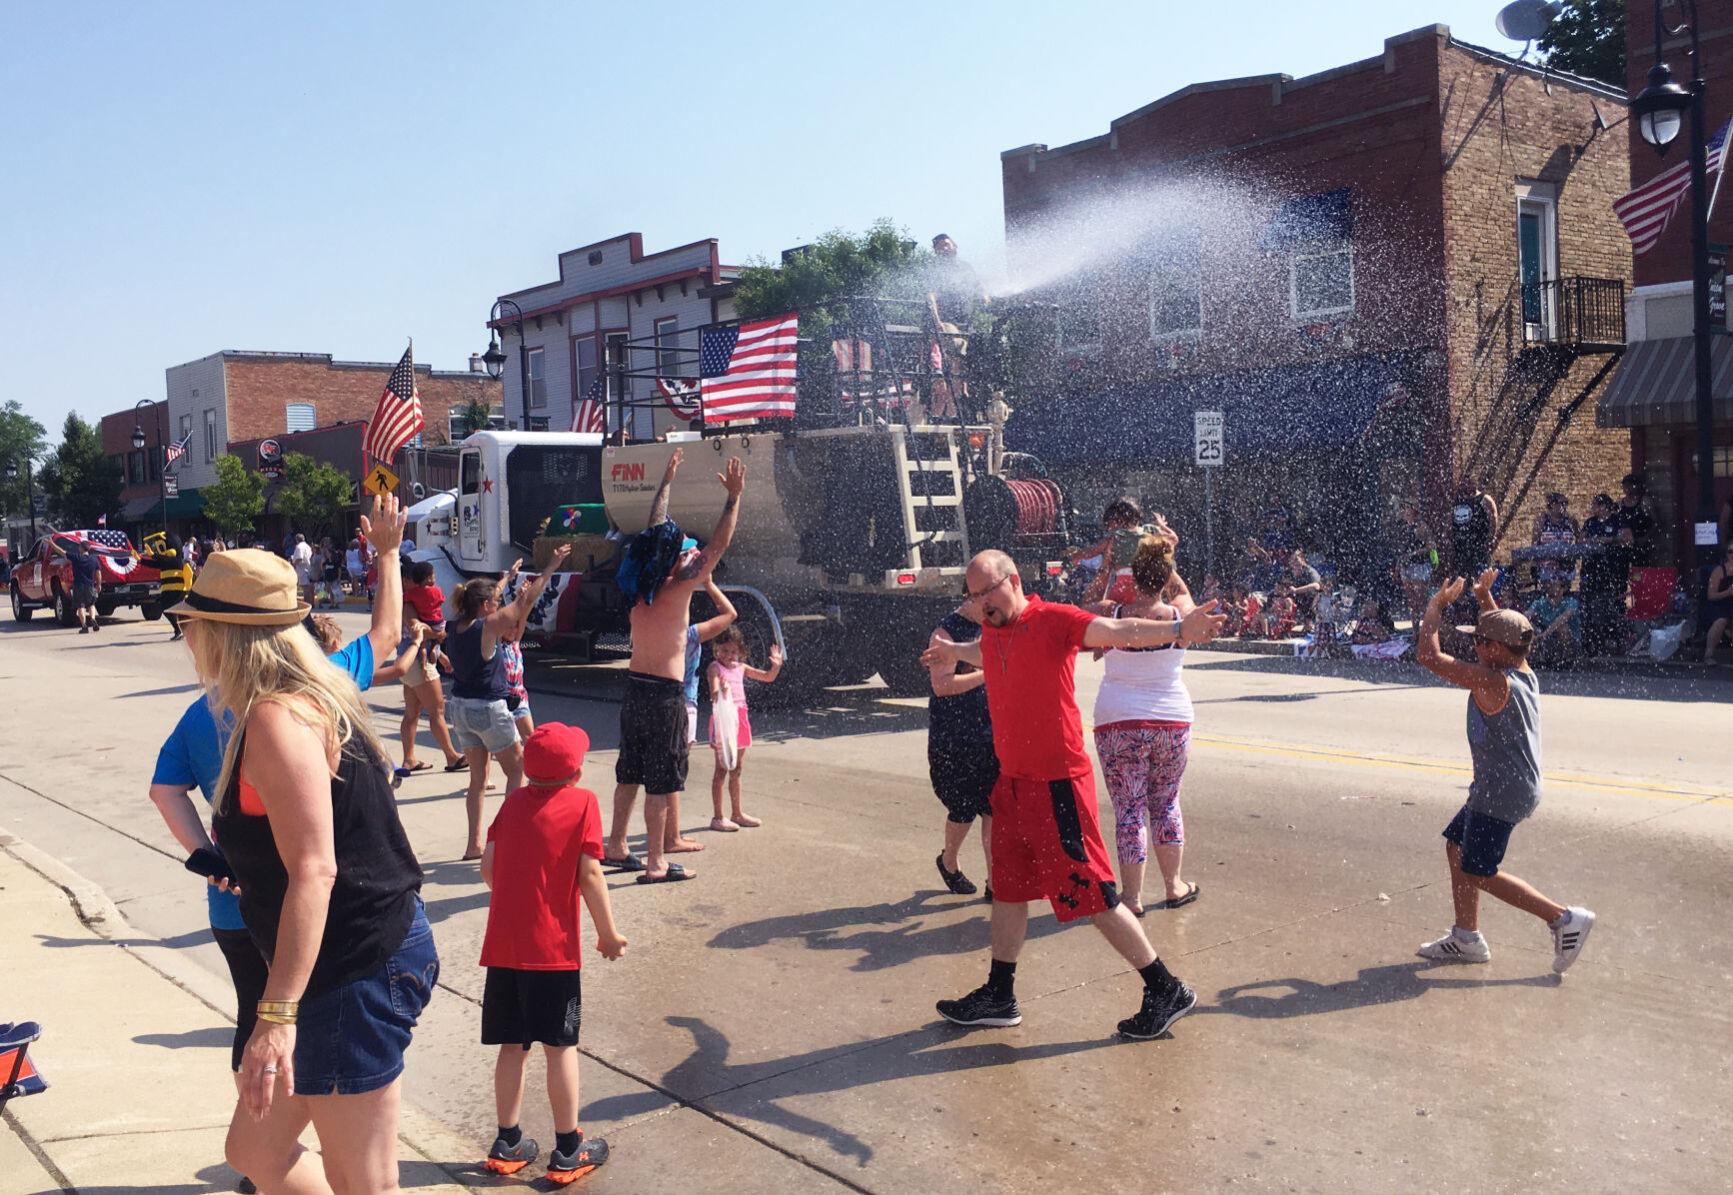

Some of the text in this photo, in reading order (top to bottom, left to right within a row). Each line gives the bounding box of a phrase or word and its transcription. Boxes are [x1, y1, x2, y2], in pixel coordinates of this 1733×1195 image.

[1197, 416, 1221, 426] SPEED
[1199, 440, 1221, 460] 25
[611, 463, 645, 481] FINN
